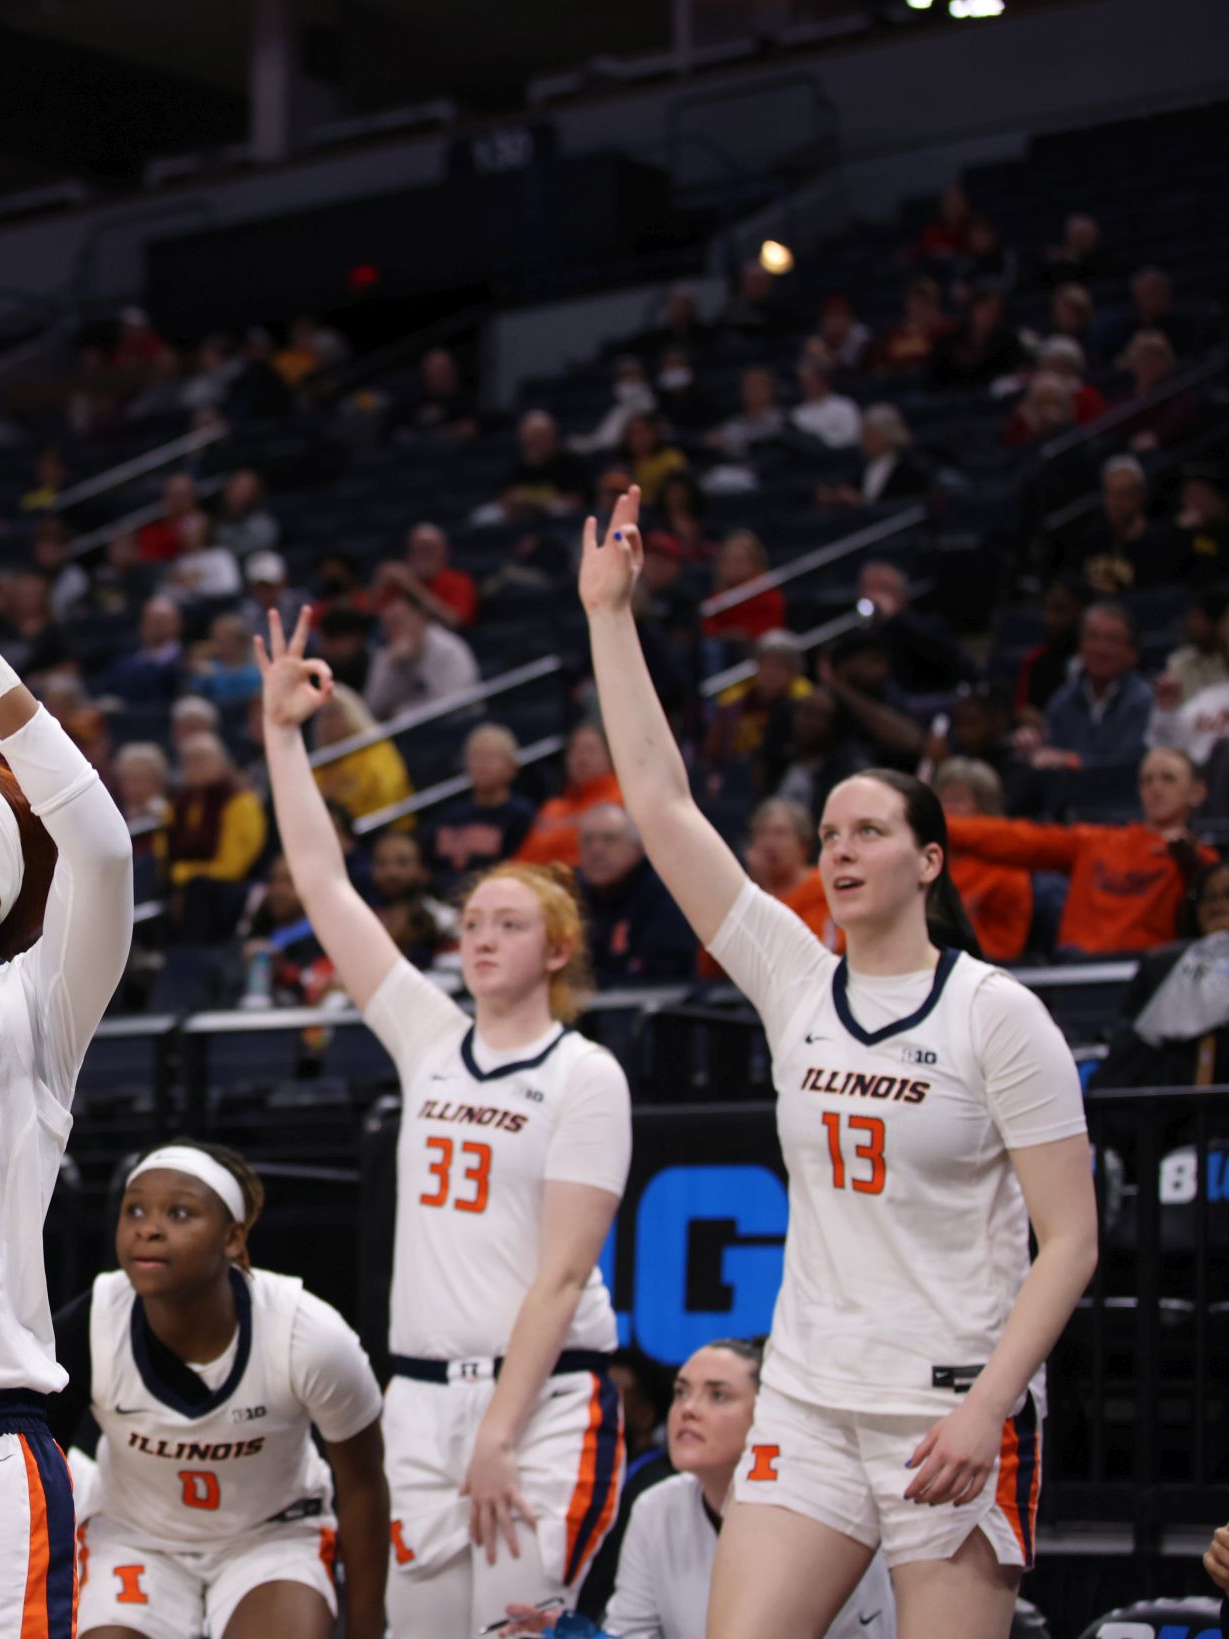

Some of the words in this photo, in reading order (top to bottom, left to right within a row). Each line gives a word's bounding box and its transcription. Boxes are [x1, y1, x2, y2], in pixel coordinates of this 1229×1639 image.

[800, 1067, 932, 1105] ILLINOIS
[416, 1099, 530, 1134] ILLINOIS
[821, 1110, 887, 1196] 13
[419, 1135, 493, 1214] 33
[127, 1431, 266, 1461] ILLINOIS
[178, 1469, 221, 1512] 0
